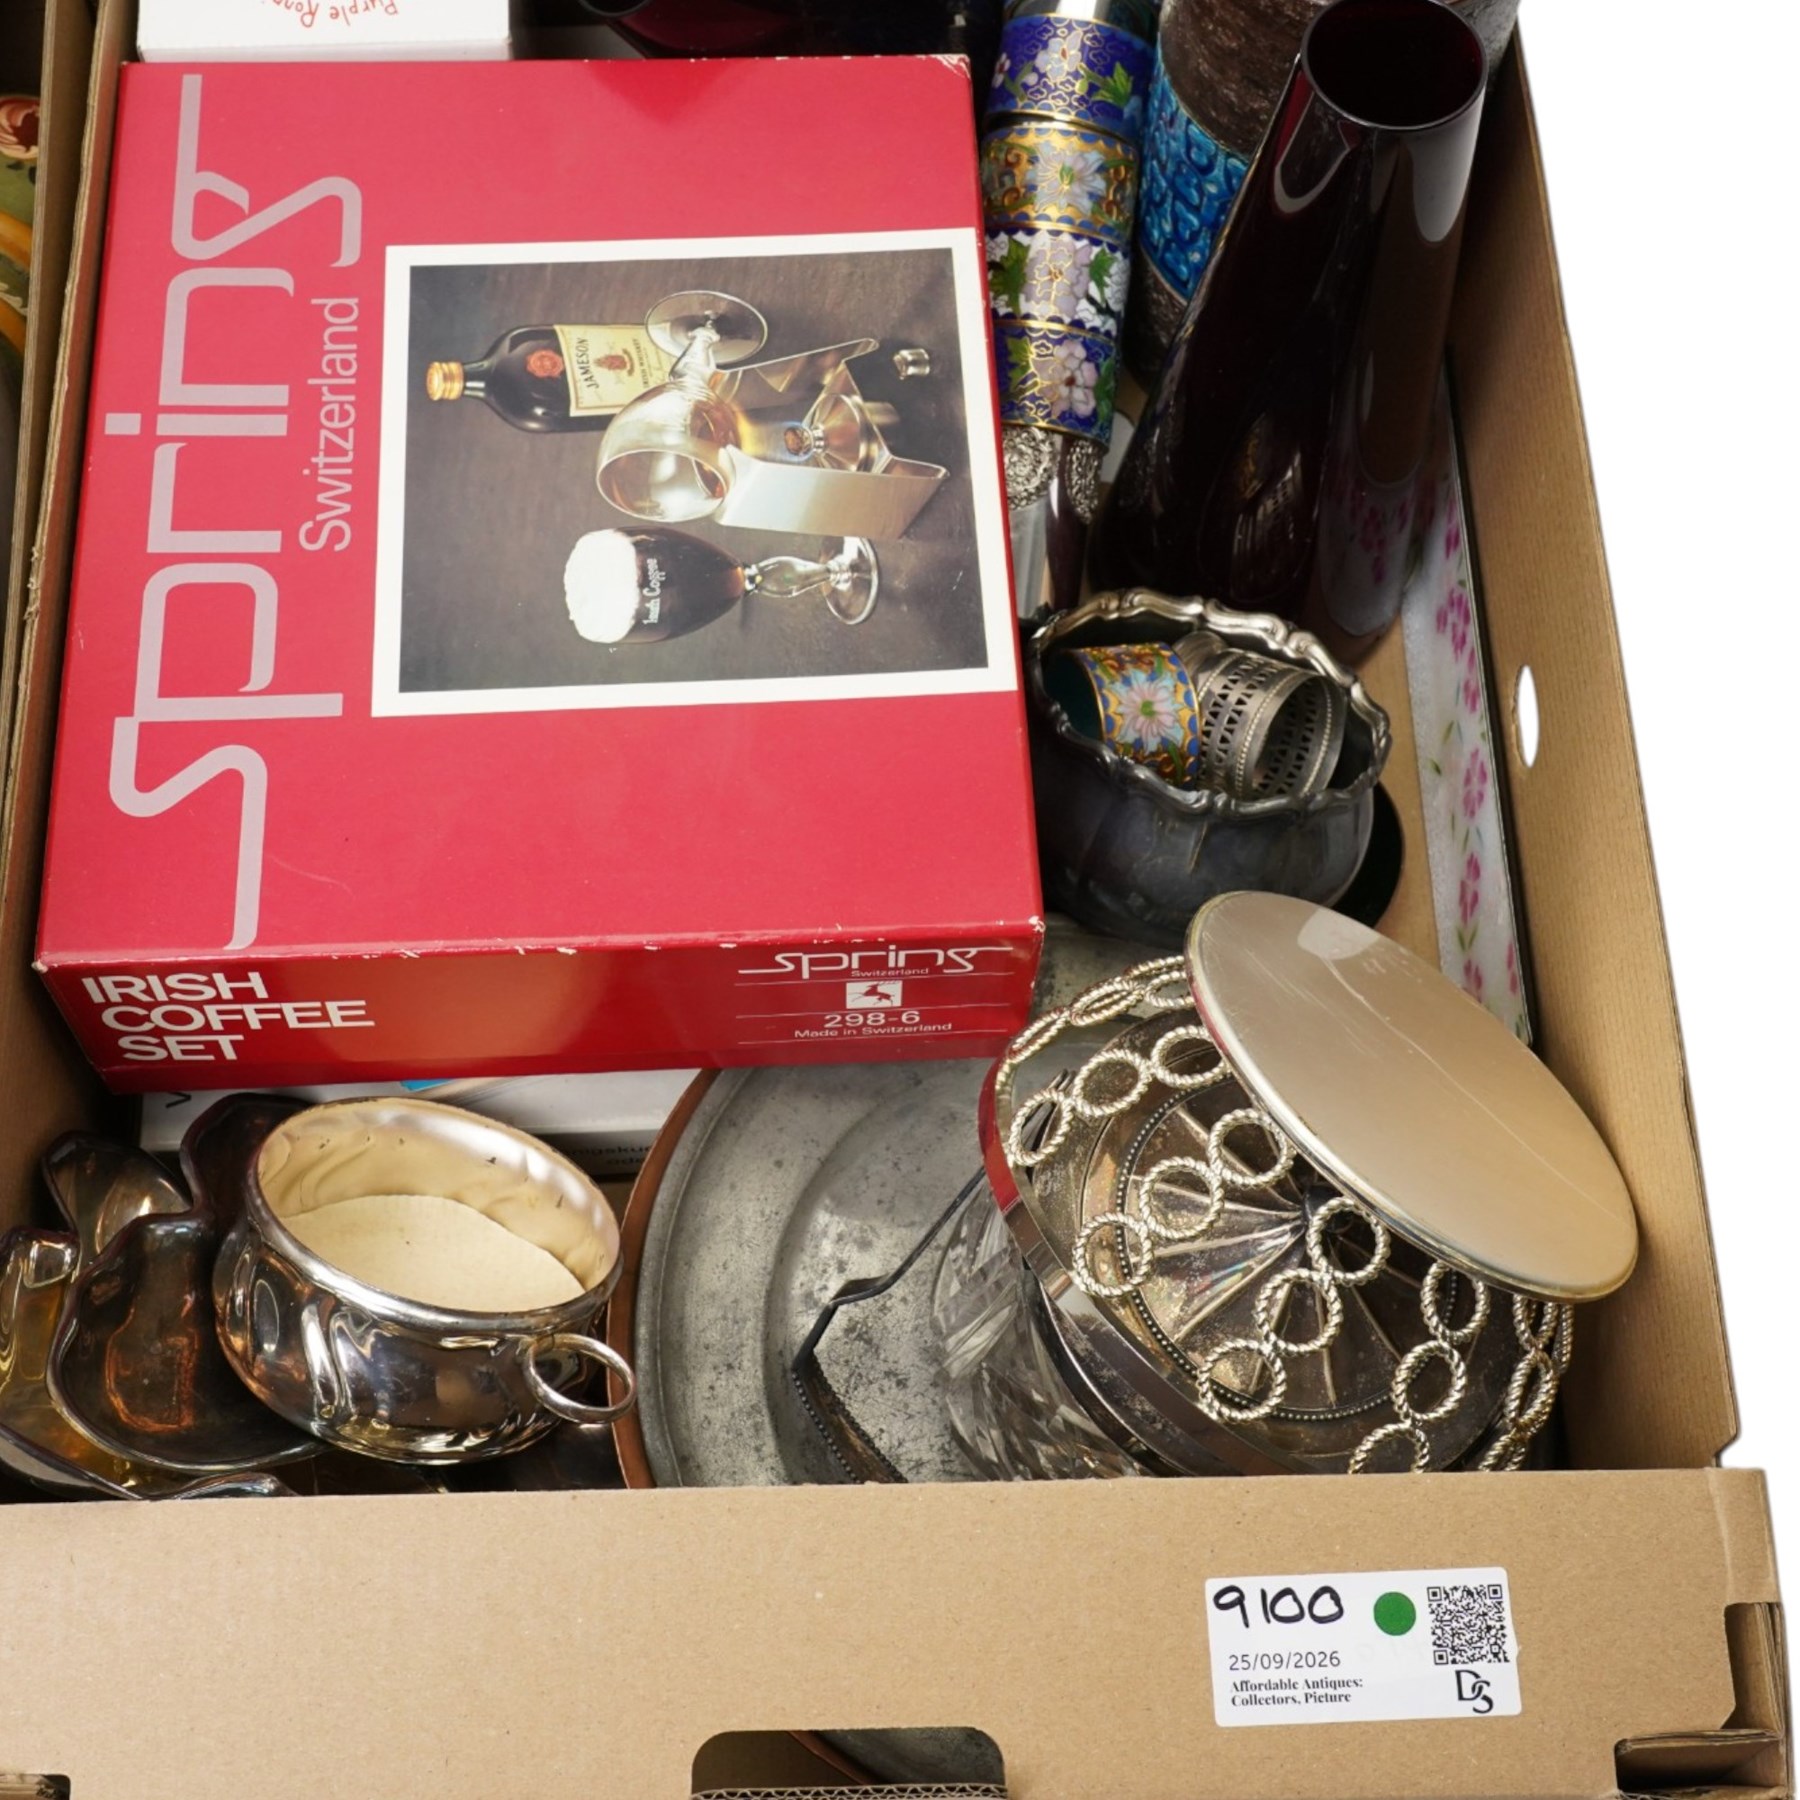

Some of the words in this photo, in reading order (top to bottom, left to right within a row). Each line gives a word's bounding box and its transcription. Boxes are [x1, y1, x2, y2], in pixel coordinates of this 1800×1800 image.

[268, 0, 319, 28] Ronn
[575, 338, 600, 389] JAMESON
[299, 297, 361, 552] Switzerland
[851, 967, 929, 978] Switzerland
[81, 971, 268, 1004] IRISH
[101, 1000, 375, 1032] COFFEE
[824, 1011, 920, 1028] 298-6
[794, 1029, 838, 1038] Made
[843, 1028, 857, 1036] in
[862, 1023, 952, 1035] Switzerland
[118, 1034, 243, 1061] SET
[1213, 1585, 1344, 1629] 9100
[1229, 1650, 1341, 1671] 25/09/2026
[1230, 1678, 1299, 1692] Affordable
[1302, 1676, 1363, 1690] Antiques:
[1231, 1693, 1301, 1706] Collectors,
[1304, 1691, 1351, 1703] Picture
